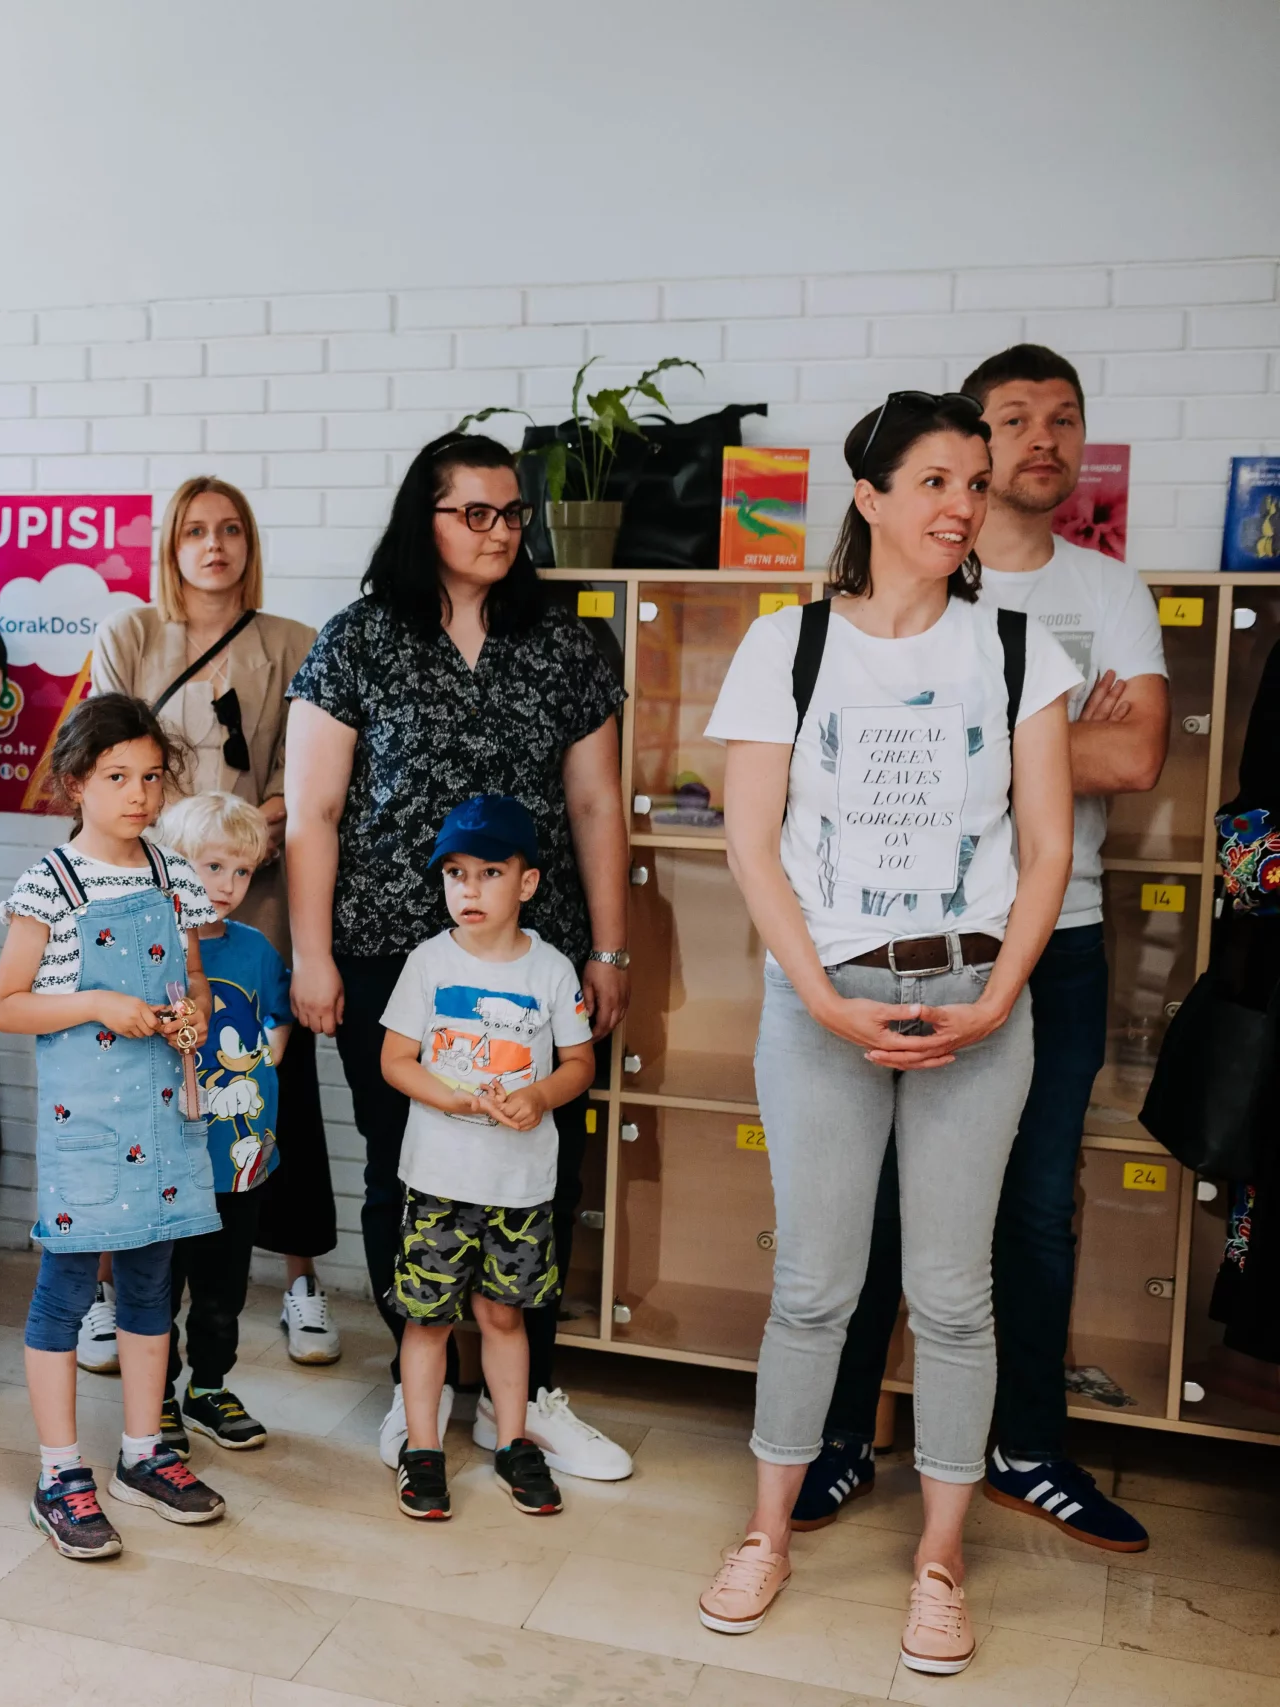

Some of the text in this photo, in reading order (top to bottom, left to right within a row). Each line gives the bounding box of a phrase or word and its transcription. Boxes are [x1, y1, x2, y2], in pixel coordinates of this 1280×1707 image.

[1174, 604, 1186, 620] 4
[858, 727, 947, 744] ETHICAL
[870, 749, 937, 764] GREEN
[861, 769, 942, 786] LEAVES
[872, 791, 931, 806] LOOK
[846, 811, 955, 828] GORGEOUS
[884, 832, 914, 848] ON
[877, 854, 917, 870] YOU
[1153, 890, 1170, 905] 14
[746, 1130, 765, 1145] 22
[1133, 1169, 1156, 1185] 24
